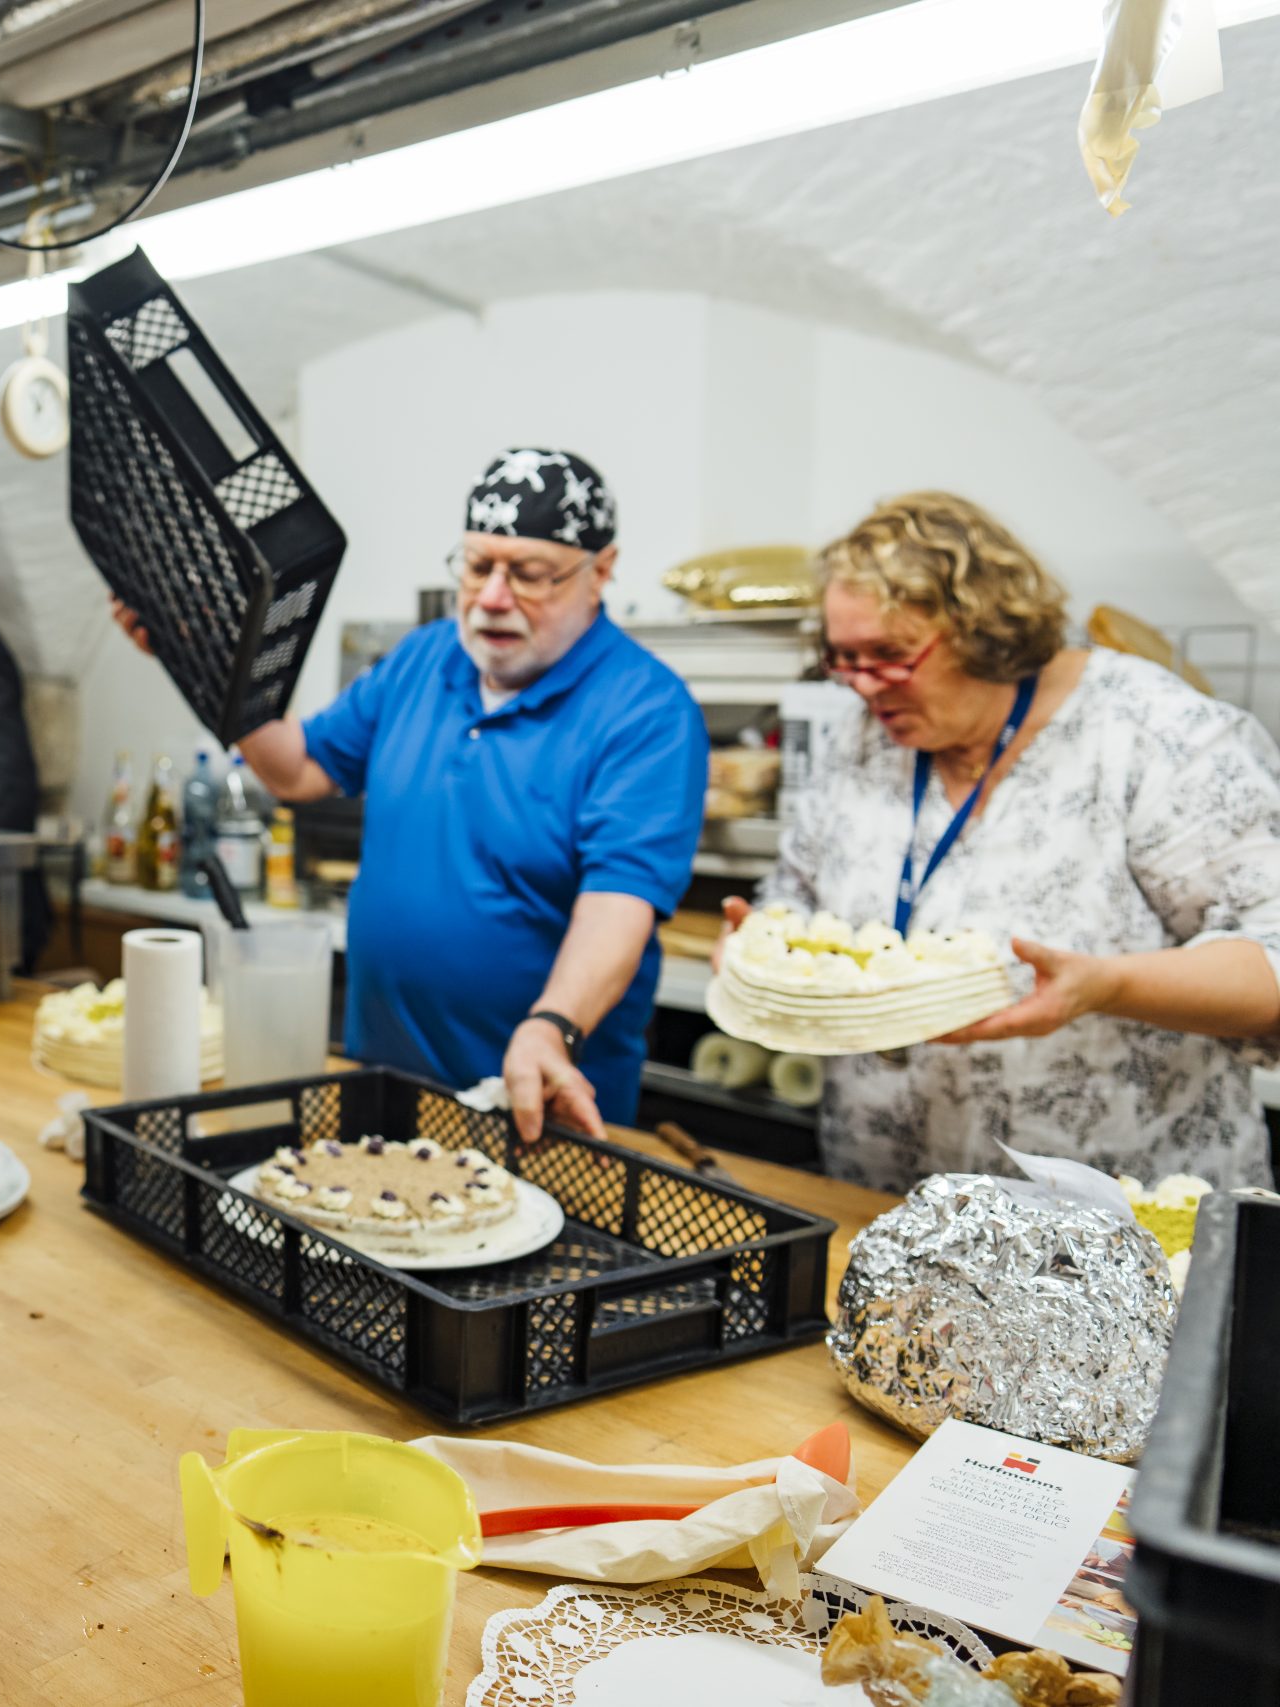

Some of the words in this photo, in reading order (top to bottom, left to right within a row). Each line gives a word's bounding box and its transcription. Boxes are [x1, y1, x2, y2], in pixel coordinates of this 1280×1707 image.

[930, 1475, 1007, 1503] COUTEAUX
[949, 1467, 1023, 1493] MESSERSET
[964, 1458, 1063, 1491] Hoffmanns
[962, 1478, 990, 1490] PCS
[993, 1487, 1030, 1503] KNIFE
[1034, 1501, 1058, 1511] SET
